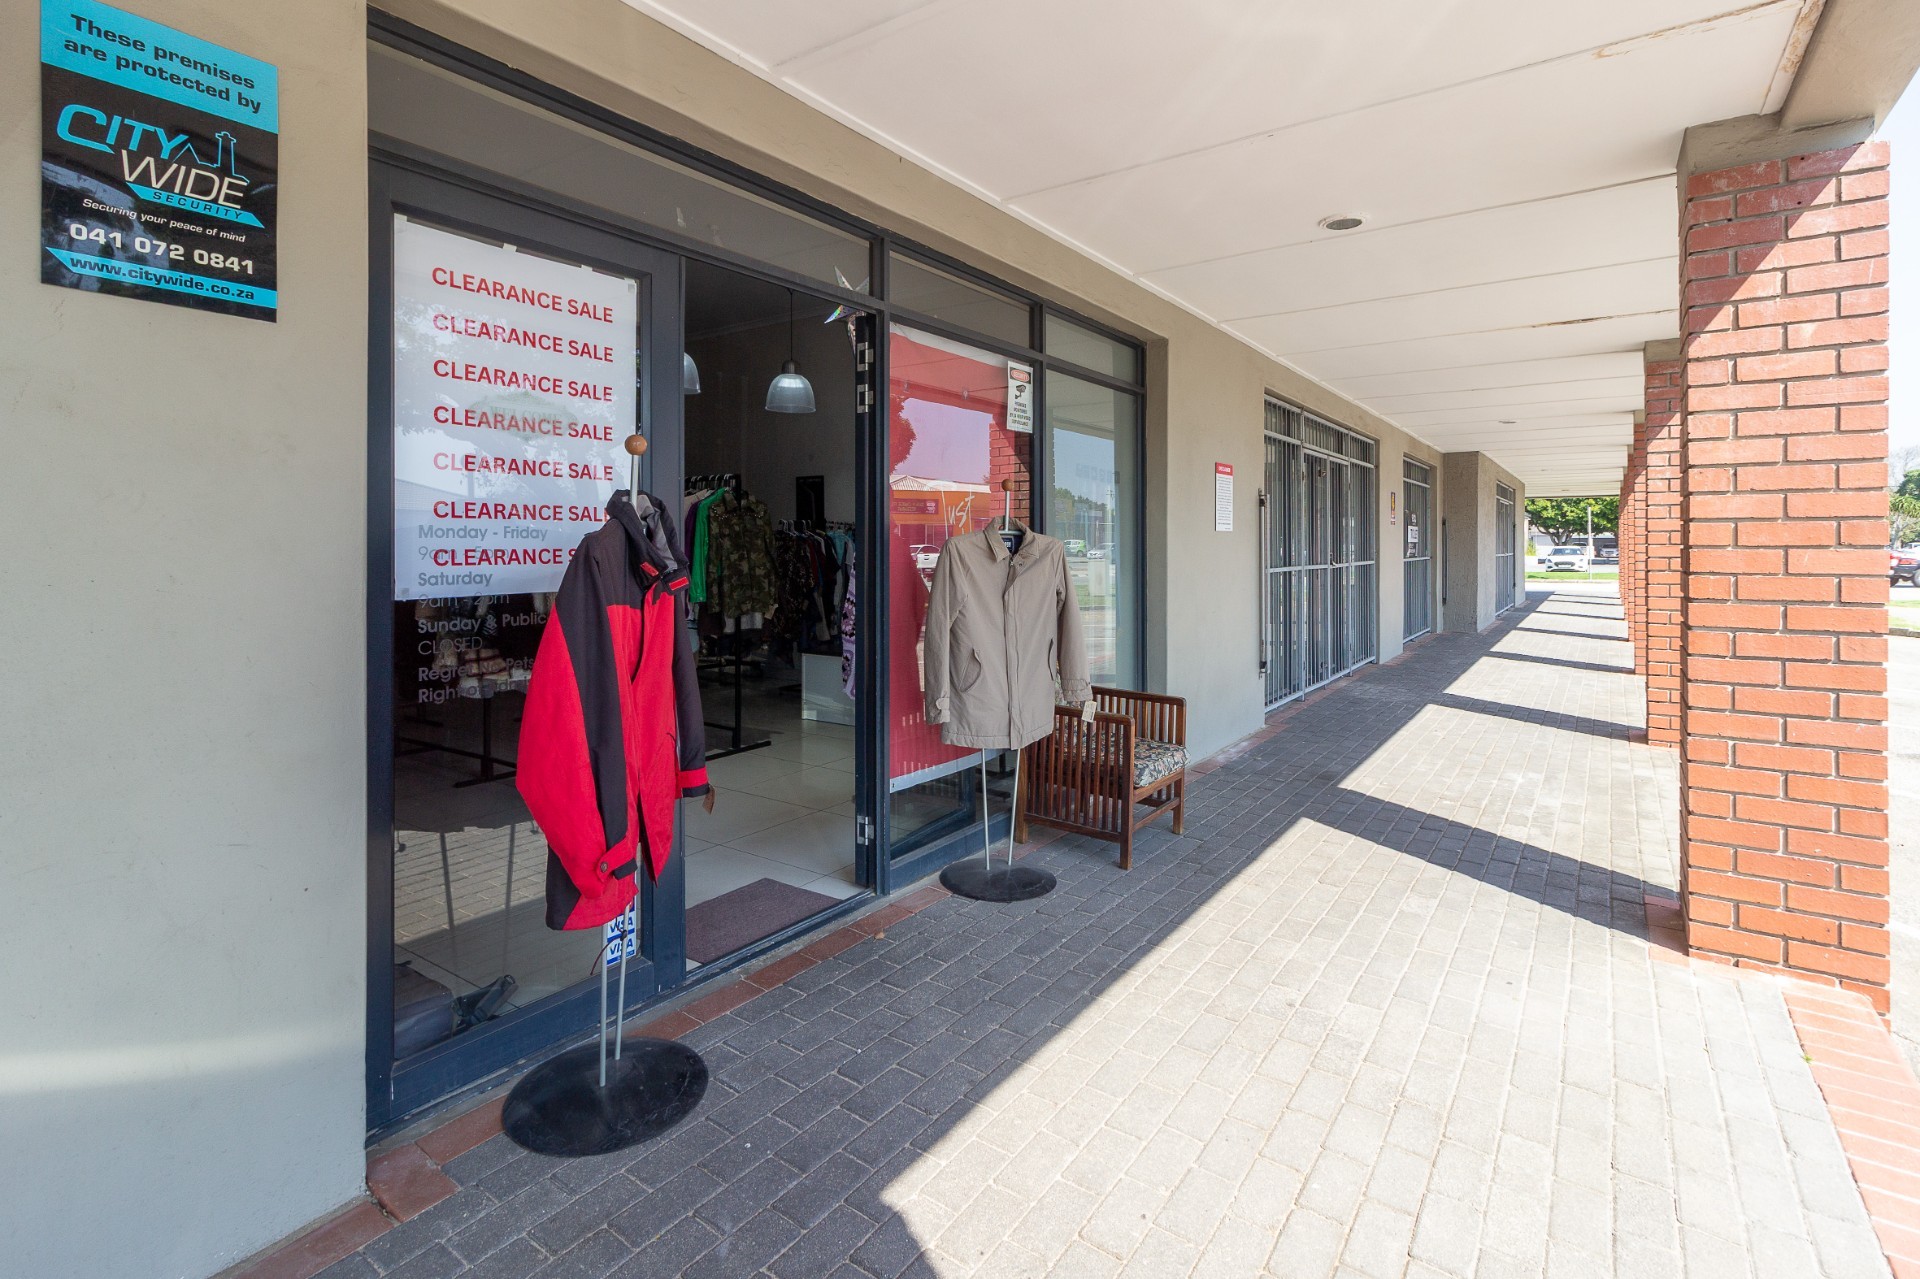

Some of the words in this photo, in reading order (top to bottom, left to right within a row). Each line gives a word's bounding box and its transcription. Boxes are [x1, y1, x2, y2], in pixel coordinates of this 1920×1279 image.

[70, 13, 146, 52] These
[153, 46, 256, 90] premises
[63, 38, 108, 62] are
[115, 55, 231, 102] protected
[237, 92, 262, 114] by
[56, 103, 189, 160] CITY
[121, 149, 248, 210] WIDE
[152, 191, 244, 220] SECURITY
[82, 198, 138, 220] Securing
[140, 210, 168, 226] your
[169, 218, 203, 235] peace
[205, 225, 218, 237] of
[219, 230, 246, 243] mind
[69, 223, 123, 248] 041
[133, 236, 186, 261] 072
[192, 249, 254, 275] 0841
[69, 256, 256, 301] www.citywide.co.za
[432, 266, 563, 312] CLEARANCE
[566, 298, 614, 324] SALE
[432, 312, 564, 354] CLEARANCE
[567, 339, 614, 363] SALE
[432, 358, 563, 395] CLEARANCE
[567, 380, 613, 402] SALE
[433, 405, 563, 437] CLEARANCE
[567, 422, 613, 442] SALE
[433, 452, 564, 478] CLEARANCE
[567, 462, 614, 481] SALE
[433, 500, 564, 521] CLEARANCE
[418, 524, 488, 541] Monday
[503, 525, 548, 542] Friday
[433, 548, 564, 567] CLEARANCE
[418, 571, 493, 587] Saturday
[418, 593, 459, 609] 9am
[417, 616, 481, 634] Sunday
[502, 611, 547, 628] Public
[417, 636, 483, 656] CLOSED
[418, 664, 474, 683] Regret
[505, 656, 534, 671] Pets
[418, 685, 462, 705] Right
[610, 938, 634, 955] VIA
